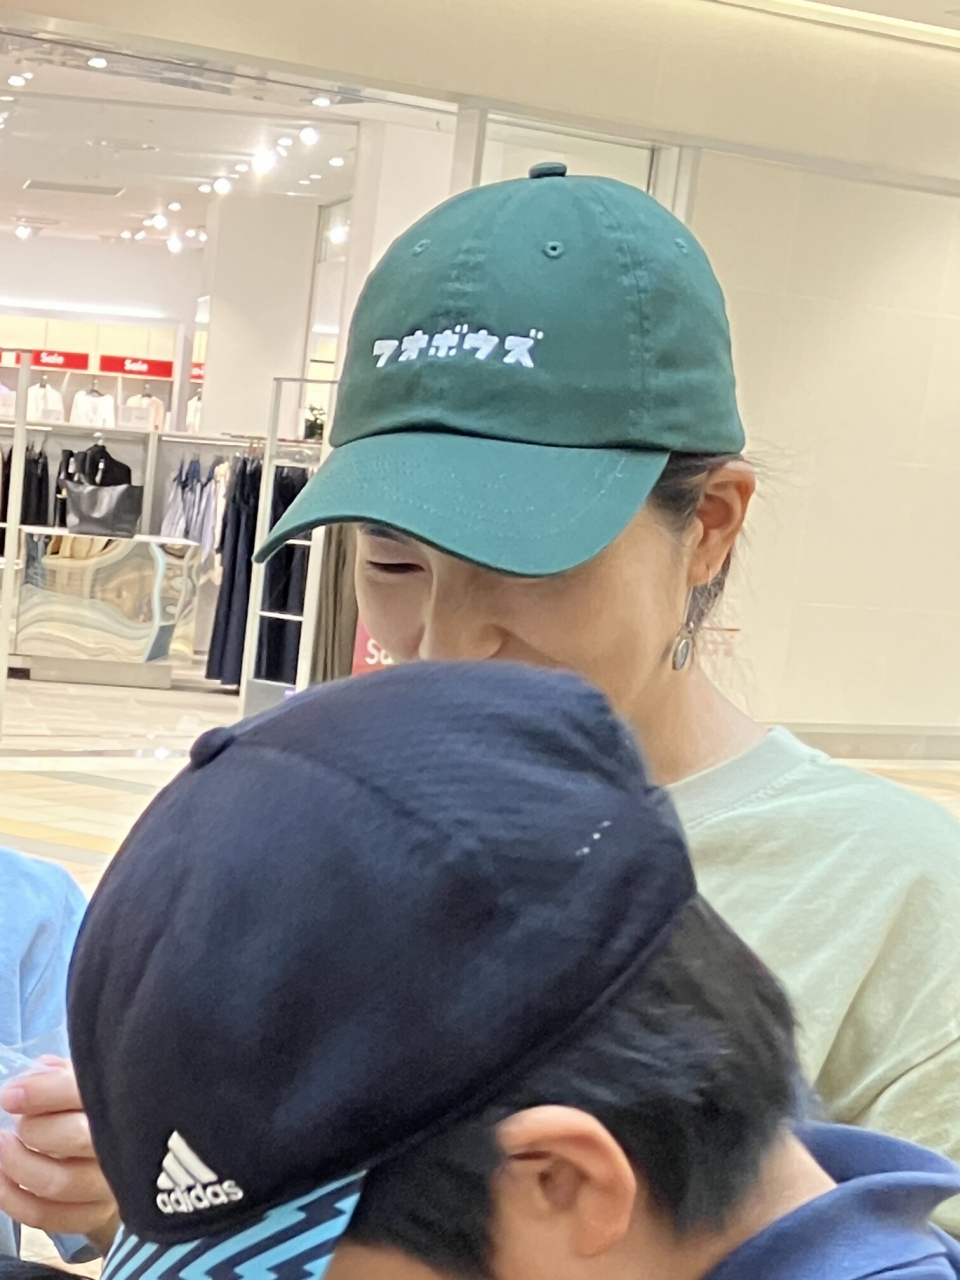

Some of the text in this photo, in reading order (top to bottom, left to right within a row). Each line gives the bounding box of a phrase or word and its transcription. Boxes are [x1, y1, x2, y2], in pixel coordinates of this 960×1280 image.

[40, 351, 65, 365] Sale
[124, 358, 148, 372] Sale
[365, 638, 394, 665] Sa
[156, 1179, 244, 1214] adidas
